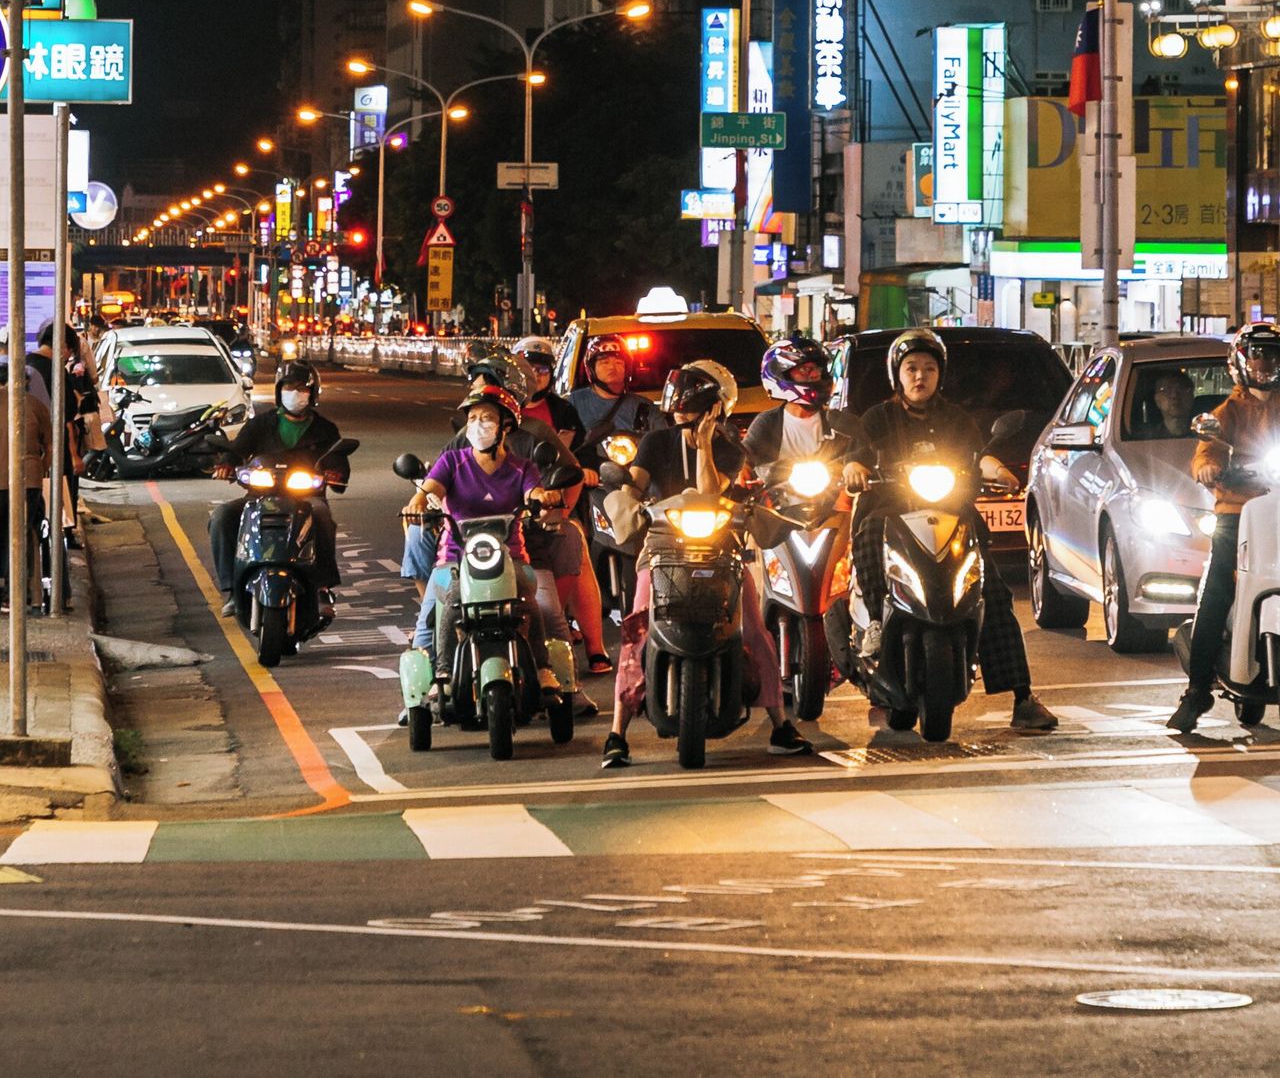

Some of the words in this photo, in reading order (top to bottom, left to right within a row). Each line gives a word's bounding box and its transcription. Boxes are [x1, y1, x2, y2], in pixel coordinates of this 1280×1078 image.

[711, 116, 776, 130] 錦平街
[710, 133, 756, 145] Jinping
[436, 203, 450, 212] 50
